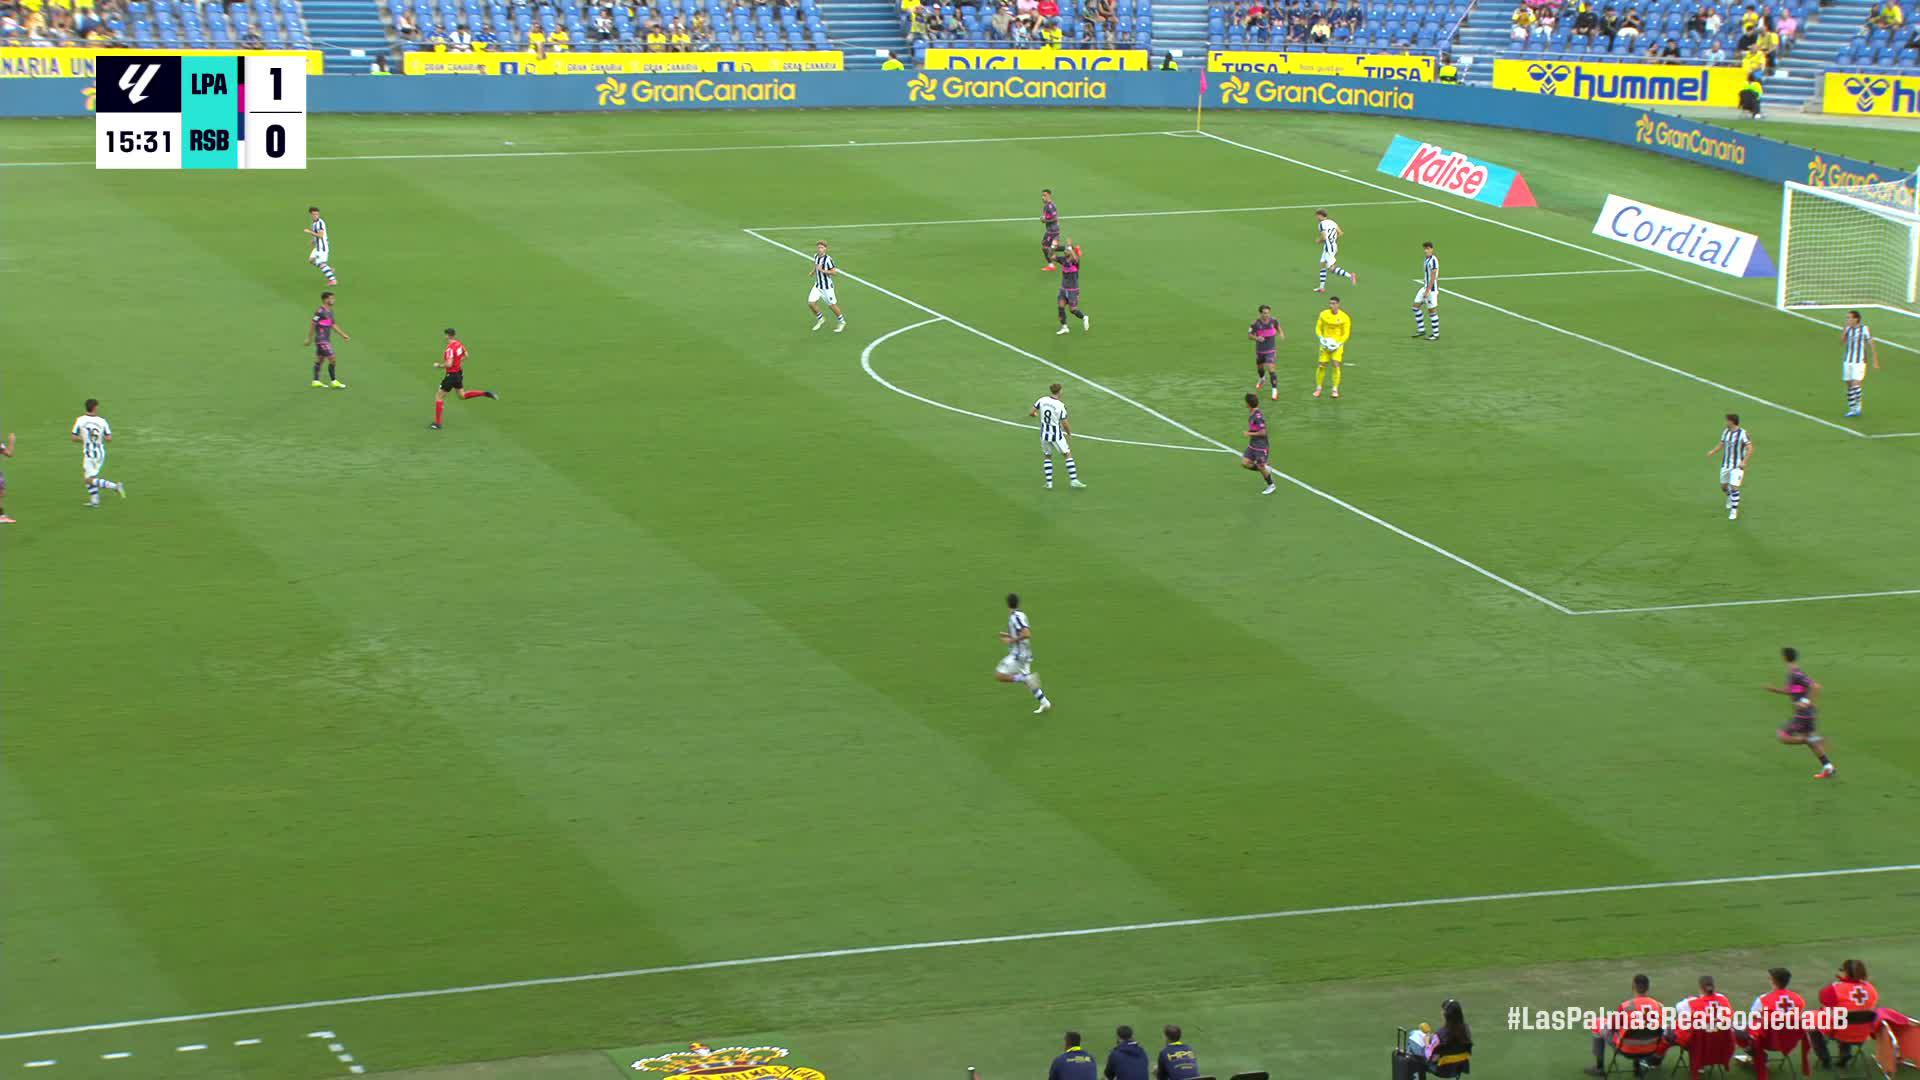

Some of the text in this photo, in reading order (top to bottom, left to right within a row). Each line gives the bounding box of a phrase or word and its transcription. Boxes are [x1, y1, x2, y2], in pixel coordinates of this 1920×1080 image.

[631, 78, 796, 102] GranCanaria
[942, 76, 1106, 99] GranCanaria
[1255, 80, 1414, 110] GranCanaria
[1573, 66, 1708, 101] hummel
[1891, 80, 1920, 112] h
[1656, 121, 1745, 165] GranCanaria
[1403, 147, 1484, 194] Kalise
[1611, 205, 1741, 268] Cordial
[1044, 409, 1052, 424] 8
[86, 427, 99, 441] 16
